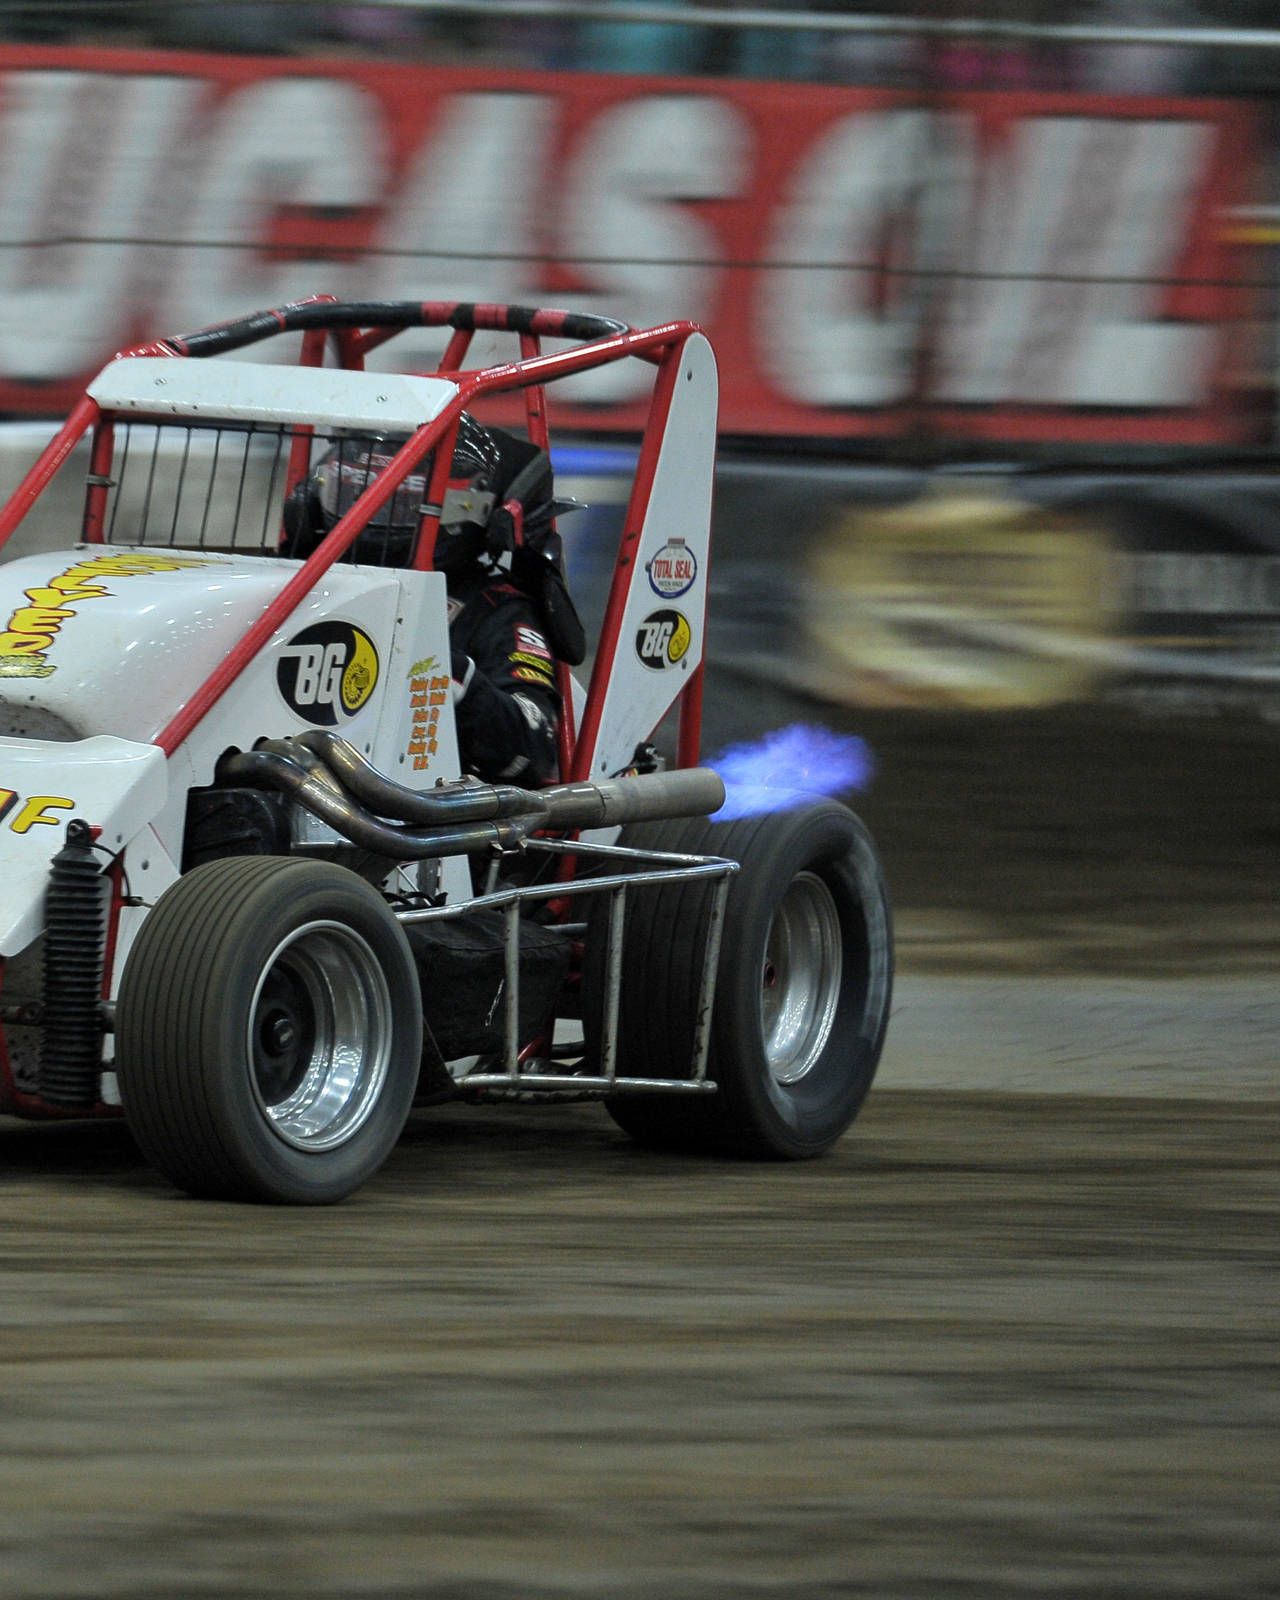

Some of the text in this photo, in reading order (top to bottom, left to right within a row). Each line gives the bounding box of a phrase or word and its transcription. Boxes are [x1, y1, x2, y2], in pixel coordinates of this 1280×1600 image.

[752, 108, 1220, 405] OIL
[653, 559, 692, 578] TOTAL SEAL
[640, 621, 673, 658] BG
[278, 642, 348, 705] BG
